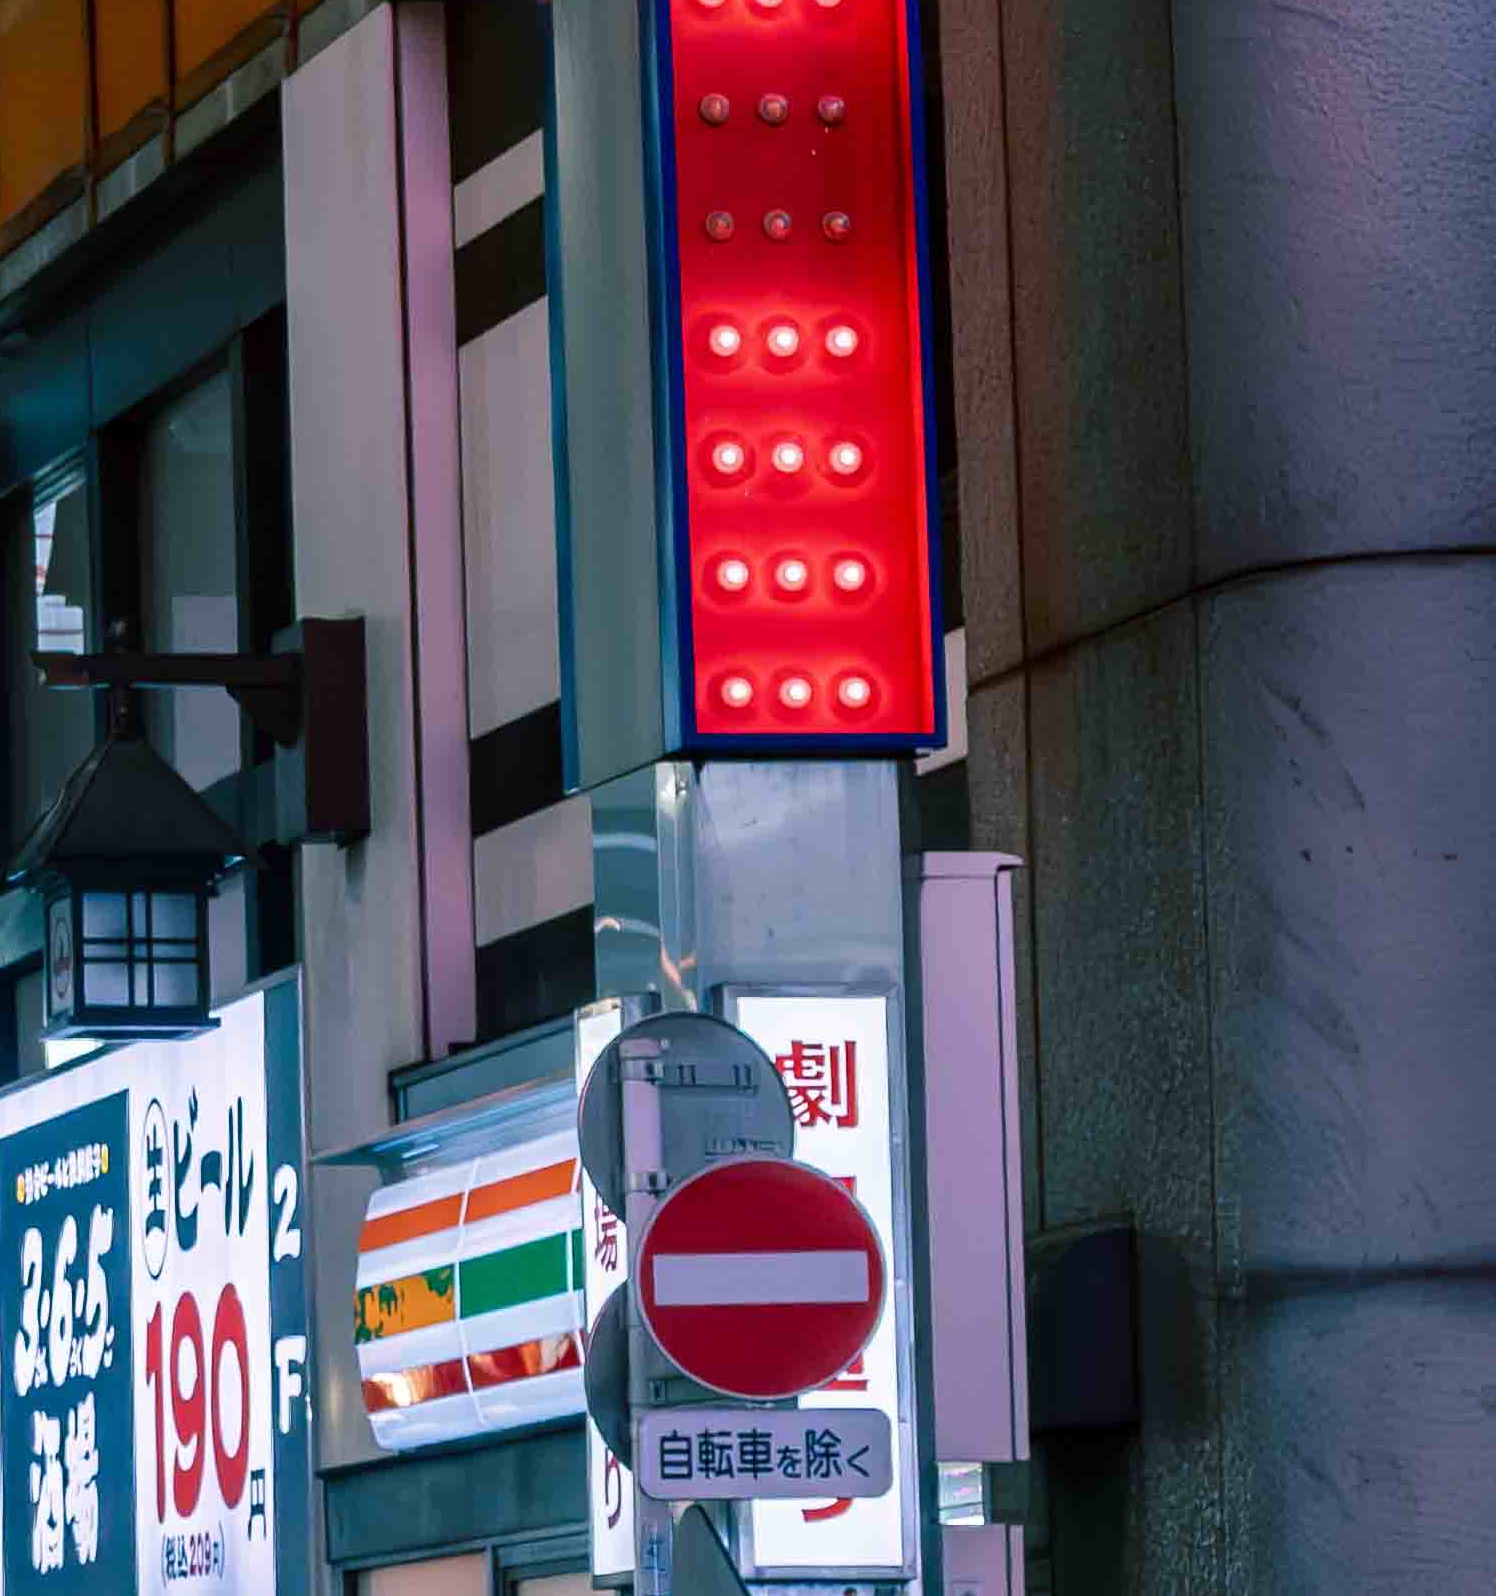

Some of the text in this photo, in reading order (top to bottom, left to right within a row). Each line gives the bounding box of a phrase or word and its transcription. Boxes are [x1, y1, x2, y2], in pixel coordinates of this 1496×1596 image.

[141, 1085, 255, 1281] 生ビール
[144, 1282, 253, 1526] 190
[657, 1427, 874, 1482] 自転車を除く
